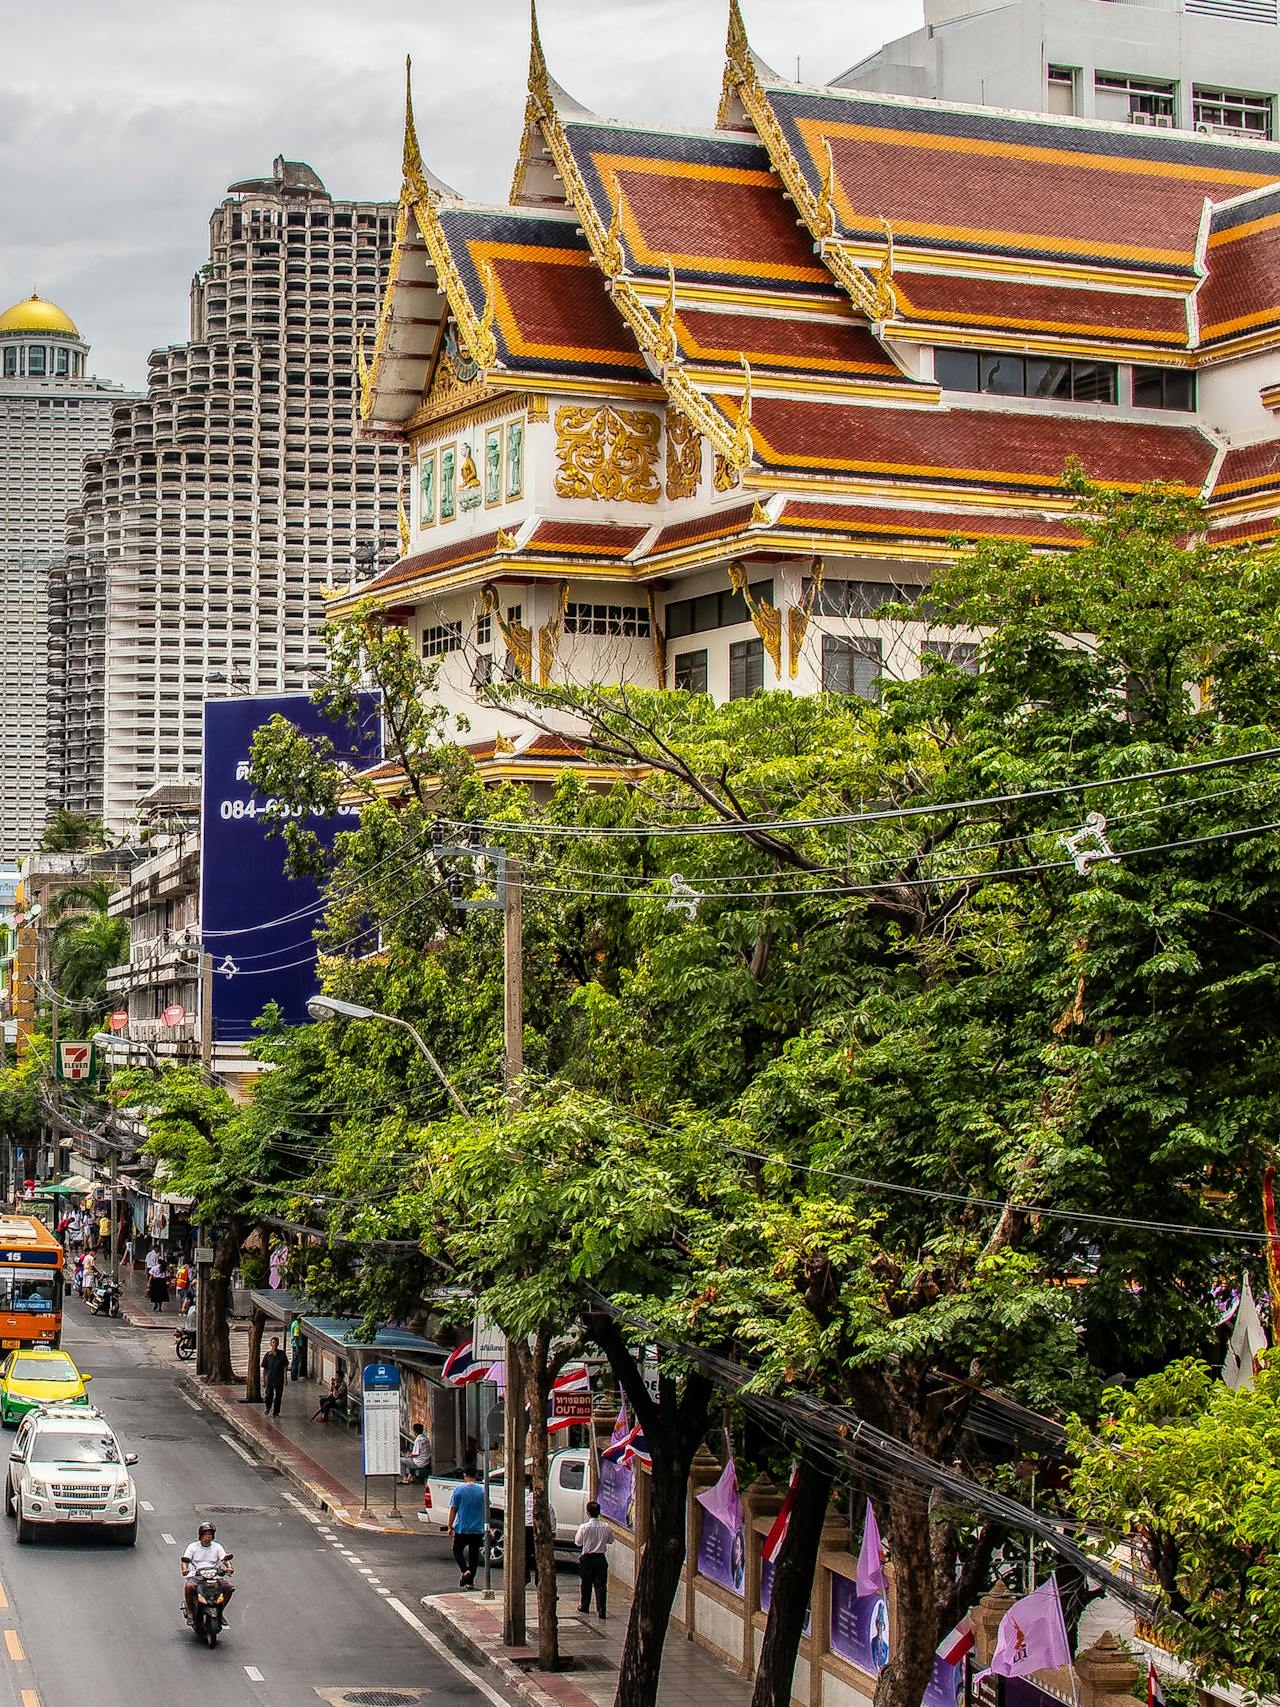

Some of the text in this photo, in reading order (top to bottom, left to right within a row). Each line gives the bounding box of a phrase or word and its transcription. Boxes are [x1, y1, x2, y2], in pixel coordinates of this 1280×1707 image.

[6, 1252, 22, 1261] 15
[555, 1396, 591, 1405] ทางออก
[555, 1406, 577, 1415] OUT
